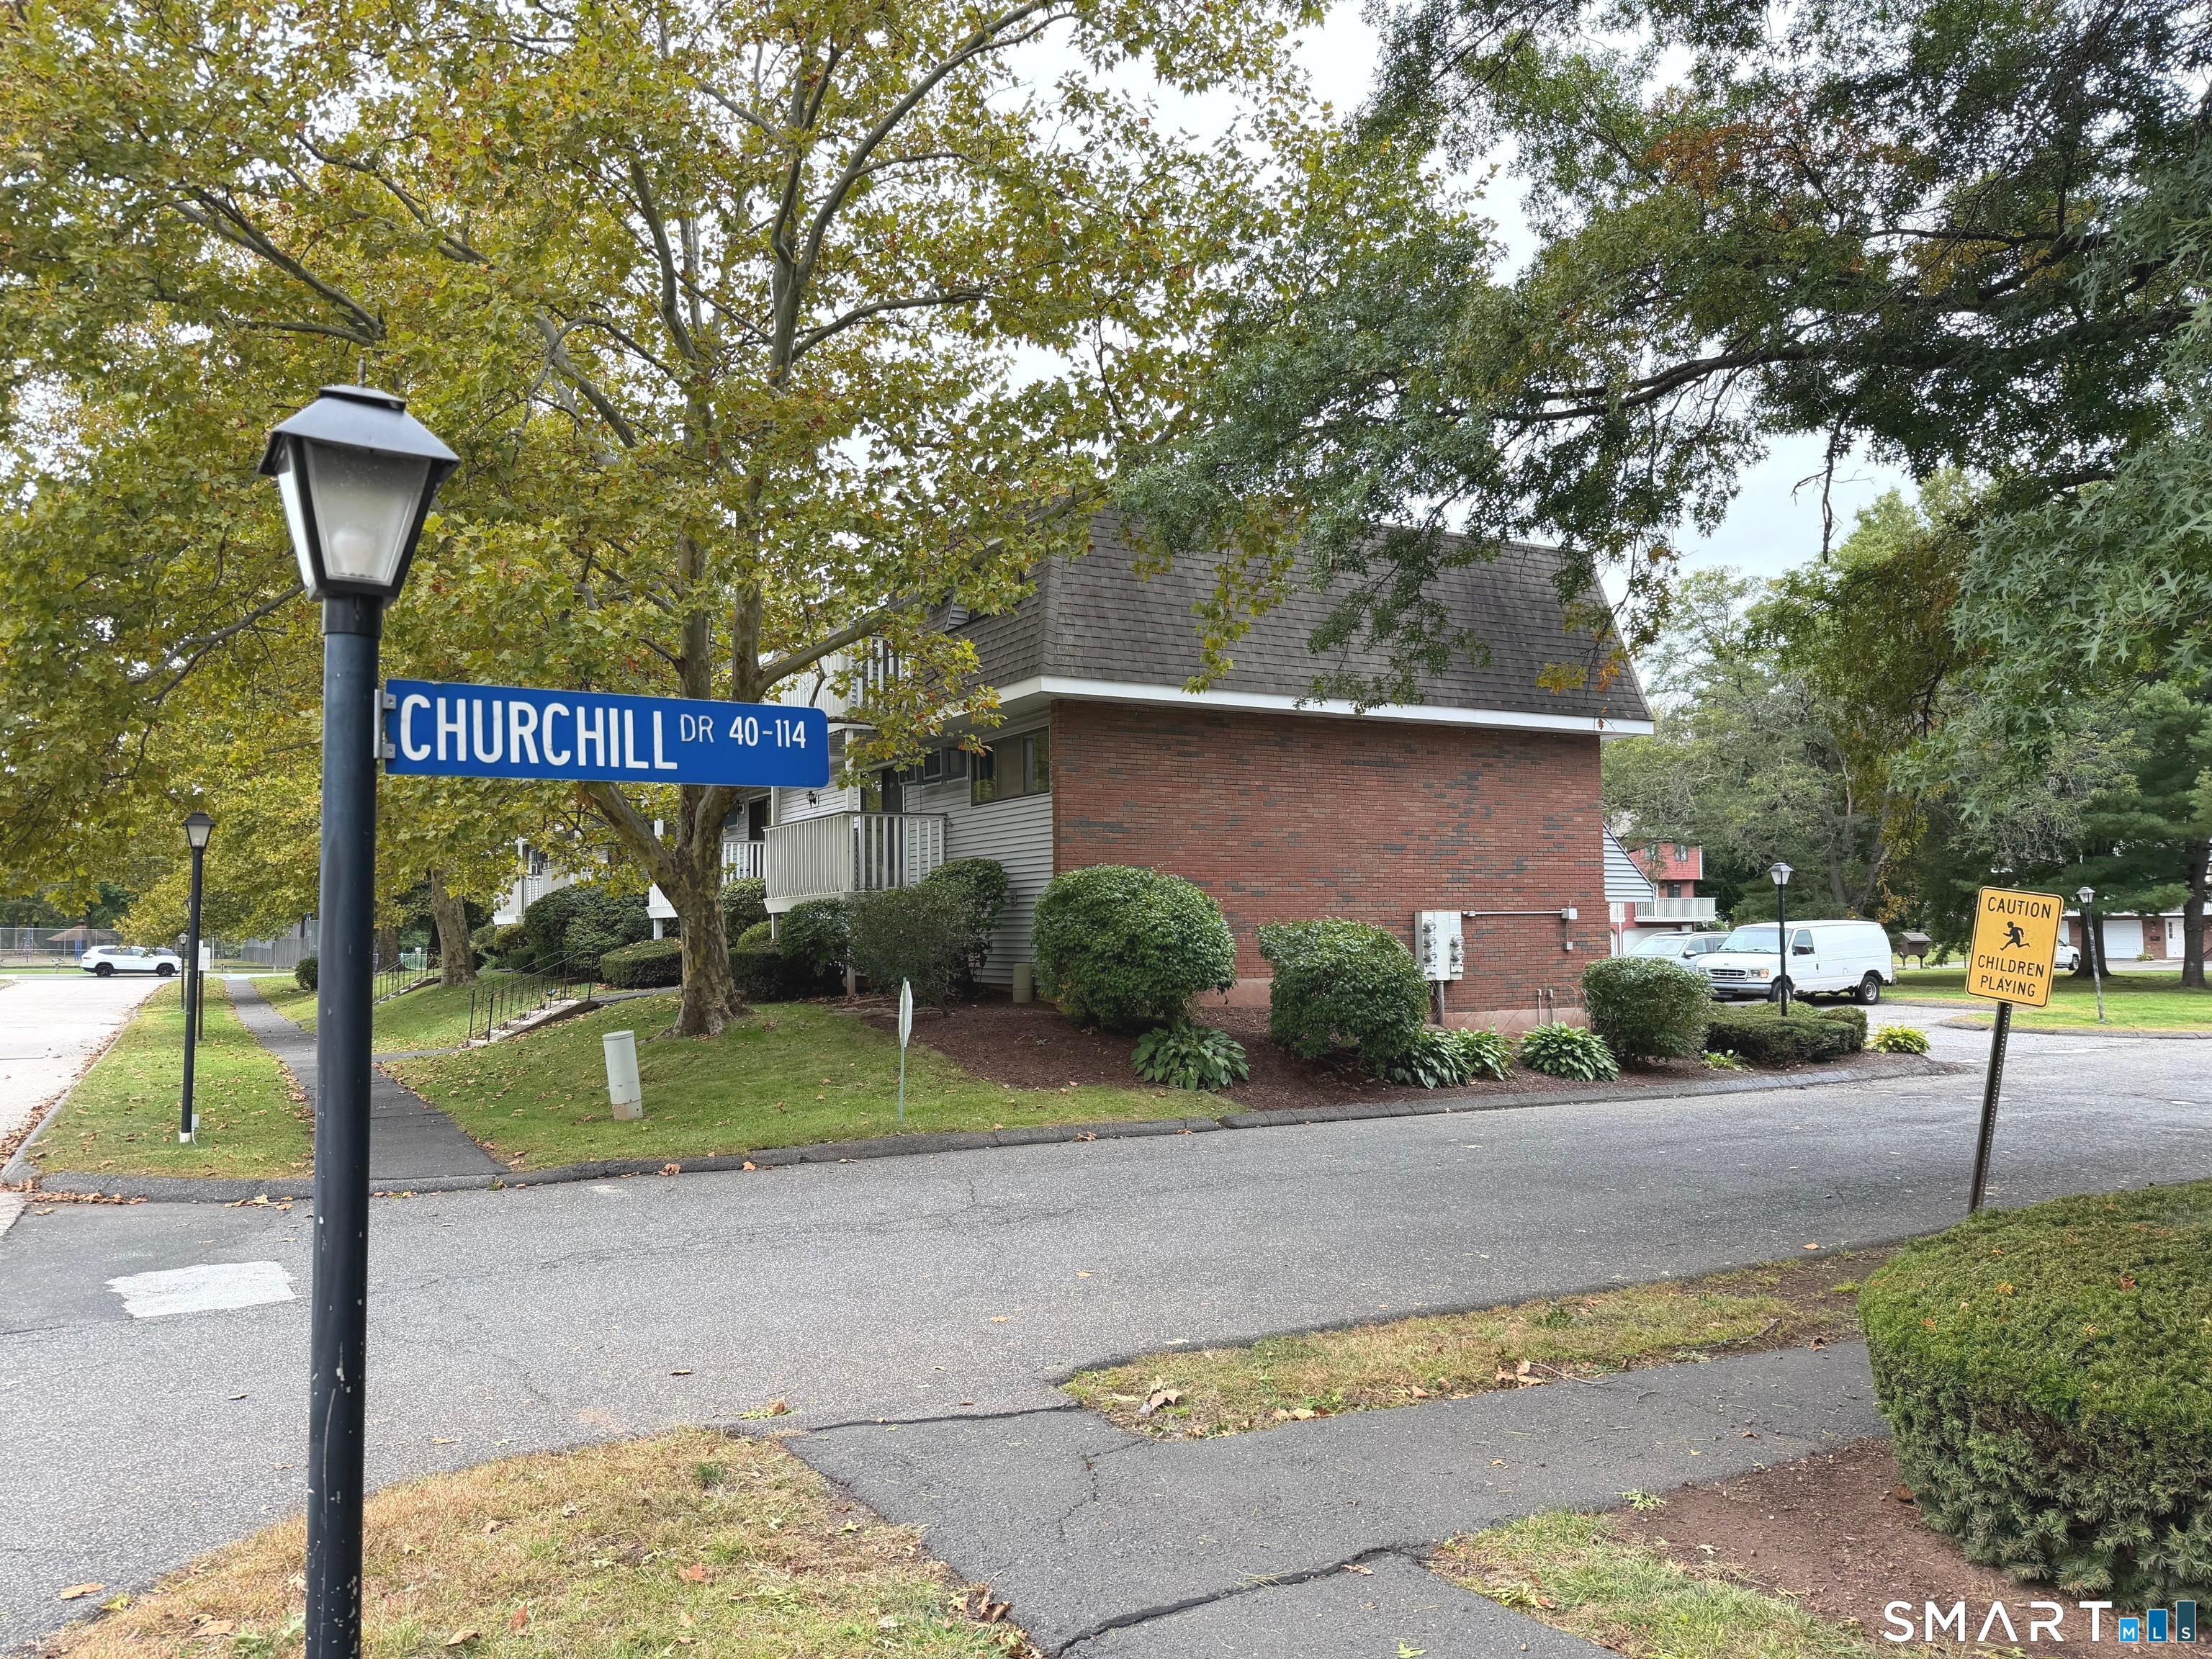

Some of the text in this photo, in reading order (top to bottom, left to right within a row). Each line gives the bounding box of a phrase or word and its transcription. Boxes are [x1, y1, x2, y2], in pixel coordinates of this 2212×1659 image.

[400, 693, 806, 770] CHURCHILL DR 40-114
[1987, 896, 2051, 919] CAUTION
[1978, 954, 2045, 978] CHILDREN
[1980, 975, 2036, 997] PLAYING
